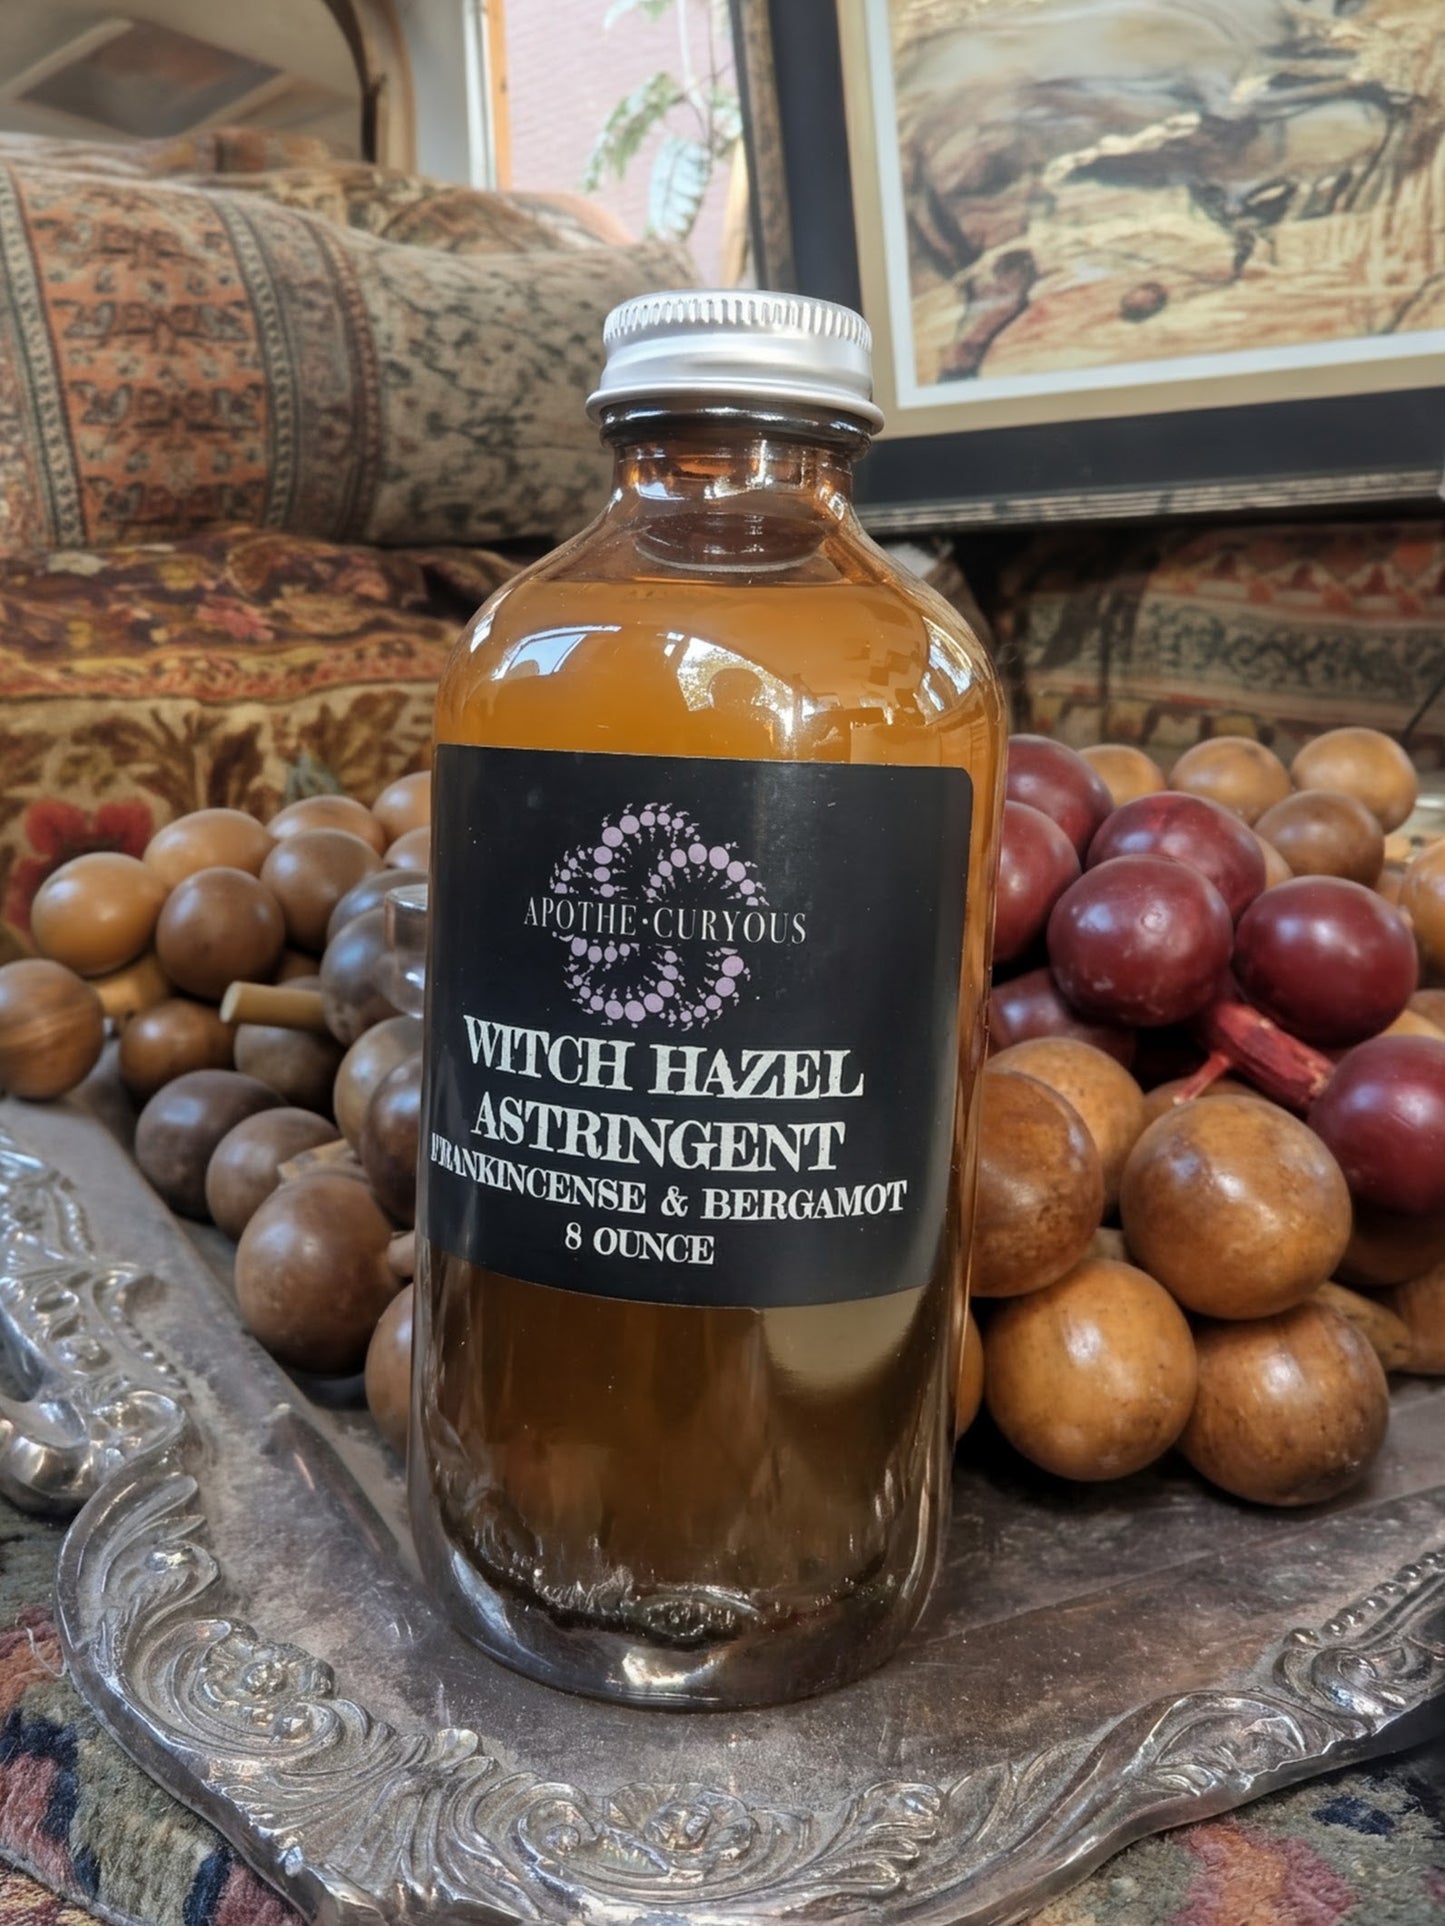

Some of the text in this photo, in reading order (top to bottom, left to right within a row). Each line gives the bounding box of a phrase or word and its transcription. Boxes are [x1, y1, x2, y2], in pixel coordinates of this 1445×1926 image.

[463, 1015, 864, 1099] WITCH HAZEL
[471, 1091, 845, 1172] ASTRINGENT
[430, 1132, 907, 1220] FRANKINCENSE & BERGAMOT
[565, 1222, 714, 1265] 8 OUNCE
